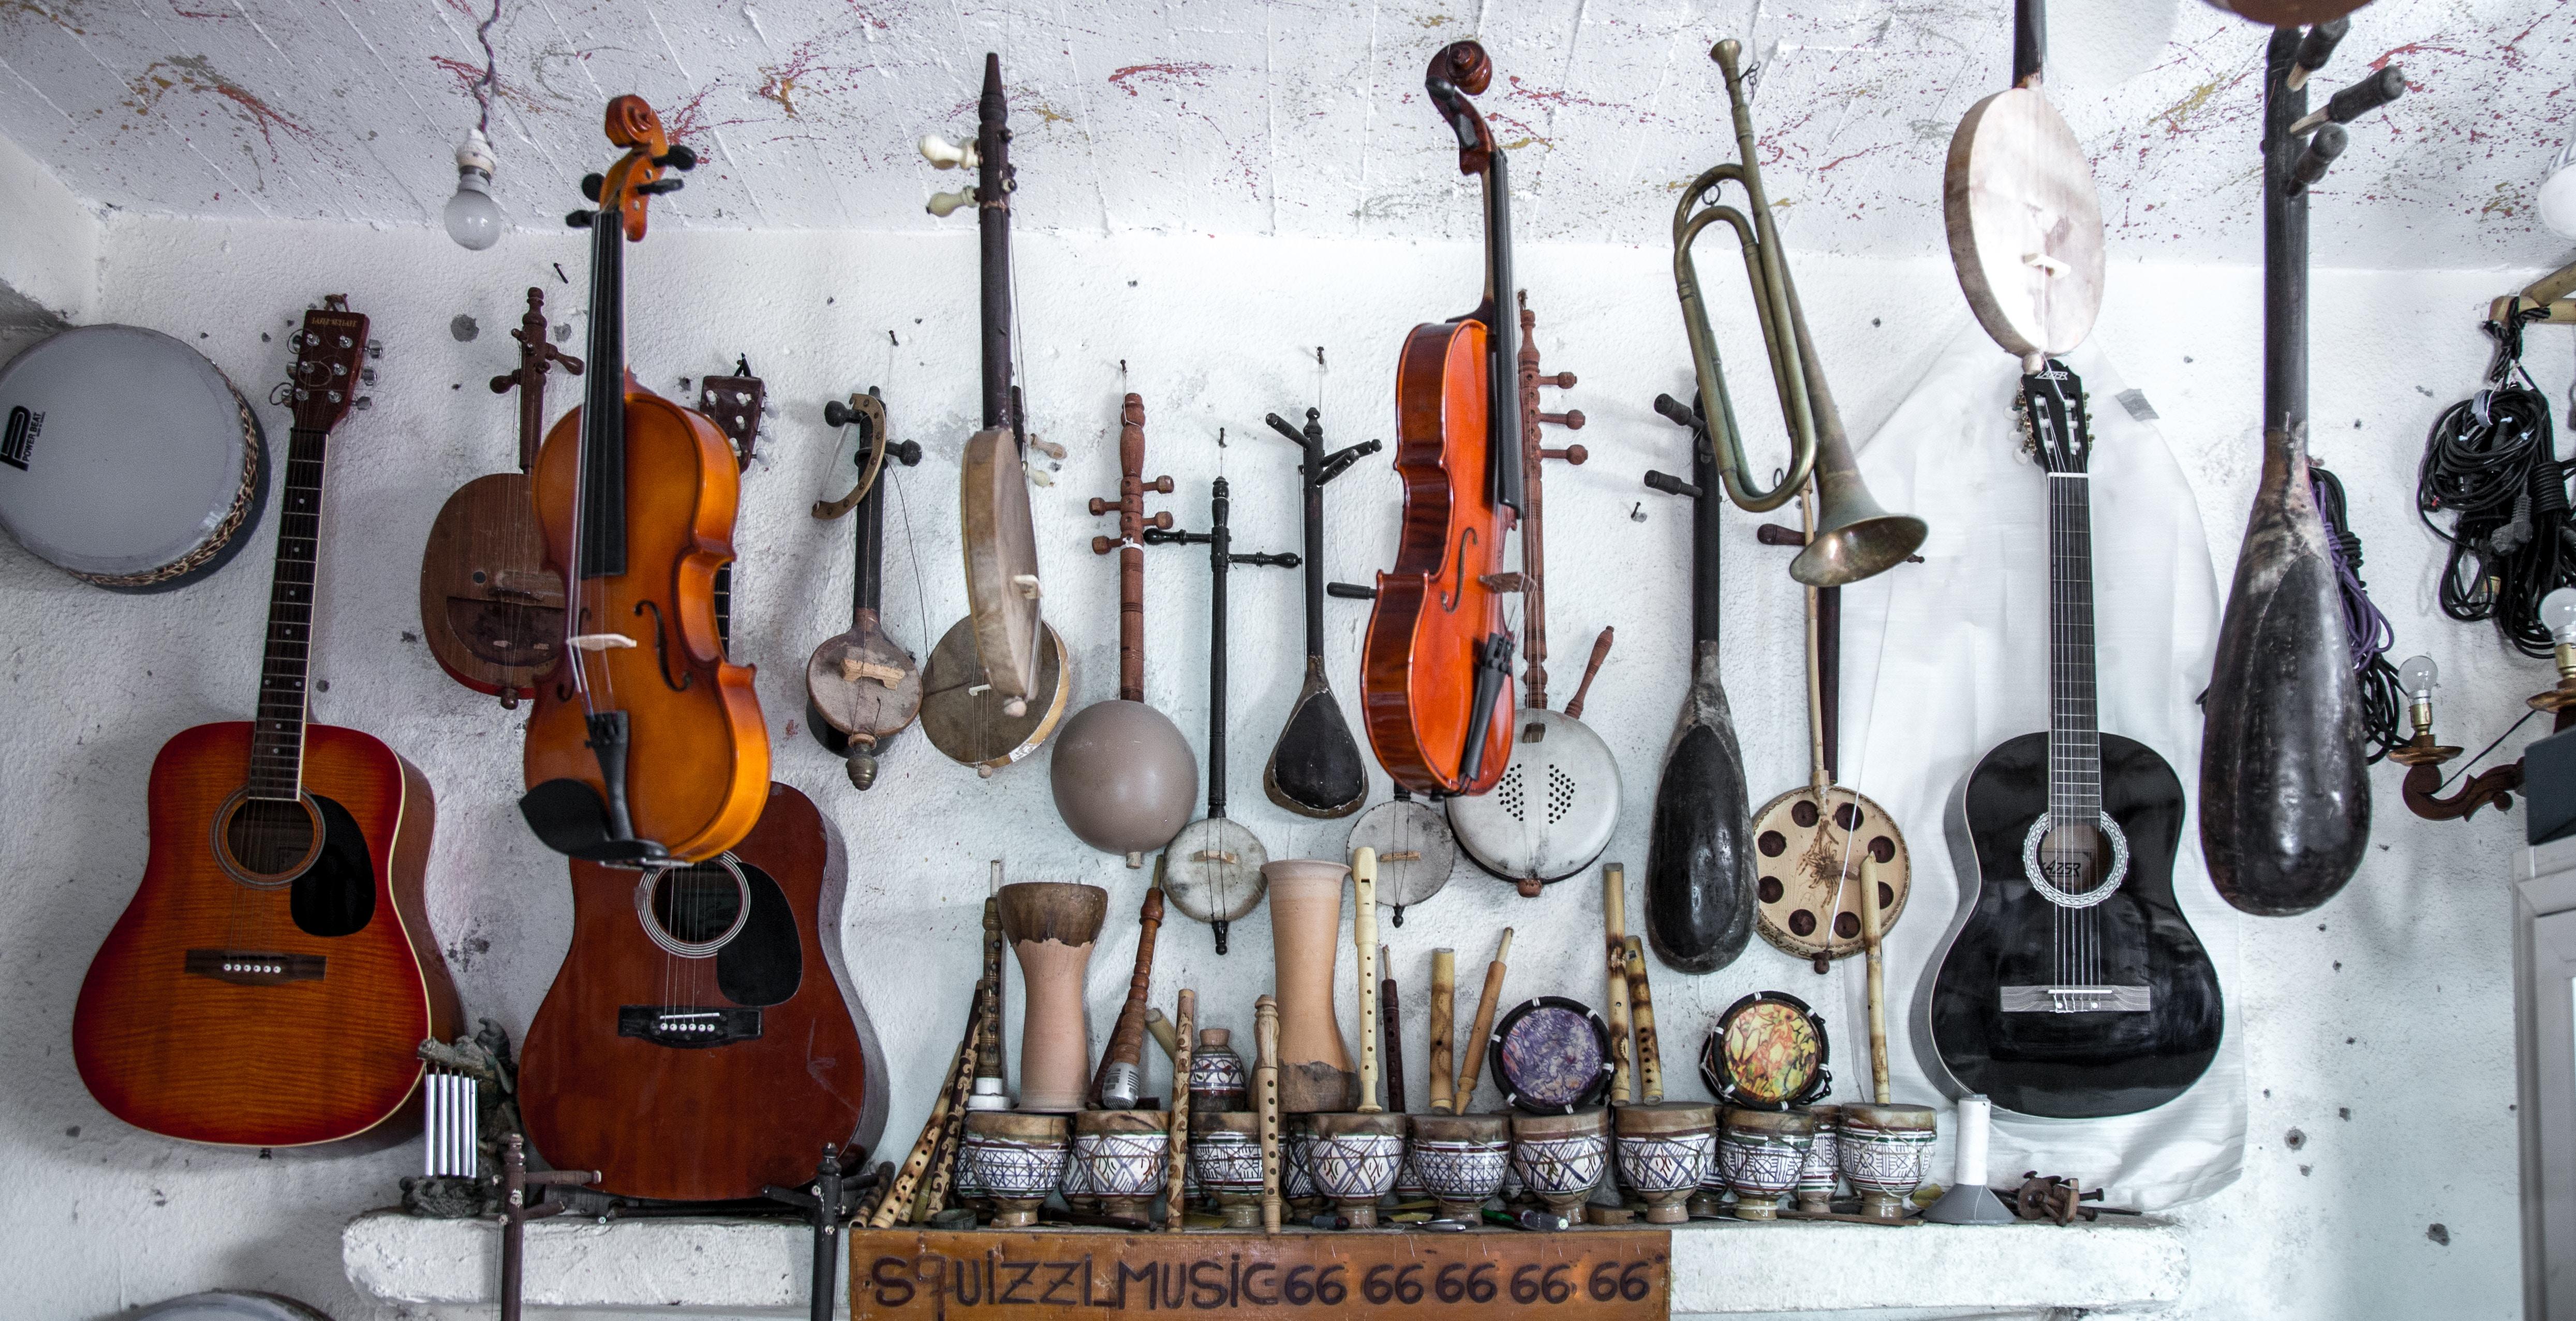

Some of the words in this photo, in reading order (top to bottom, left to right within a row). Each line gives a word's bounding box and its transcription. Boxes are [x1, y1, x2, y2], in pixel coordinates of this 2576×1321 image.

[22, 433, 36, 462] POWER
[29, 412, 42, 433] BEAT
[2043, 857, 2081, 877] AZER
[1363, 1263, 1425, 1305] 66
[1435, 1261, 1498, 1305] 66
[1510, 1263, 1571, 1305] 66
[1588, 1260, 1651, 1302] 66
